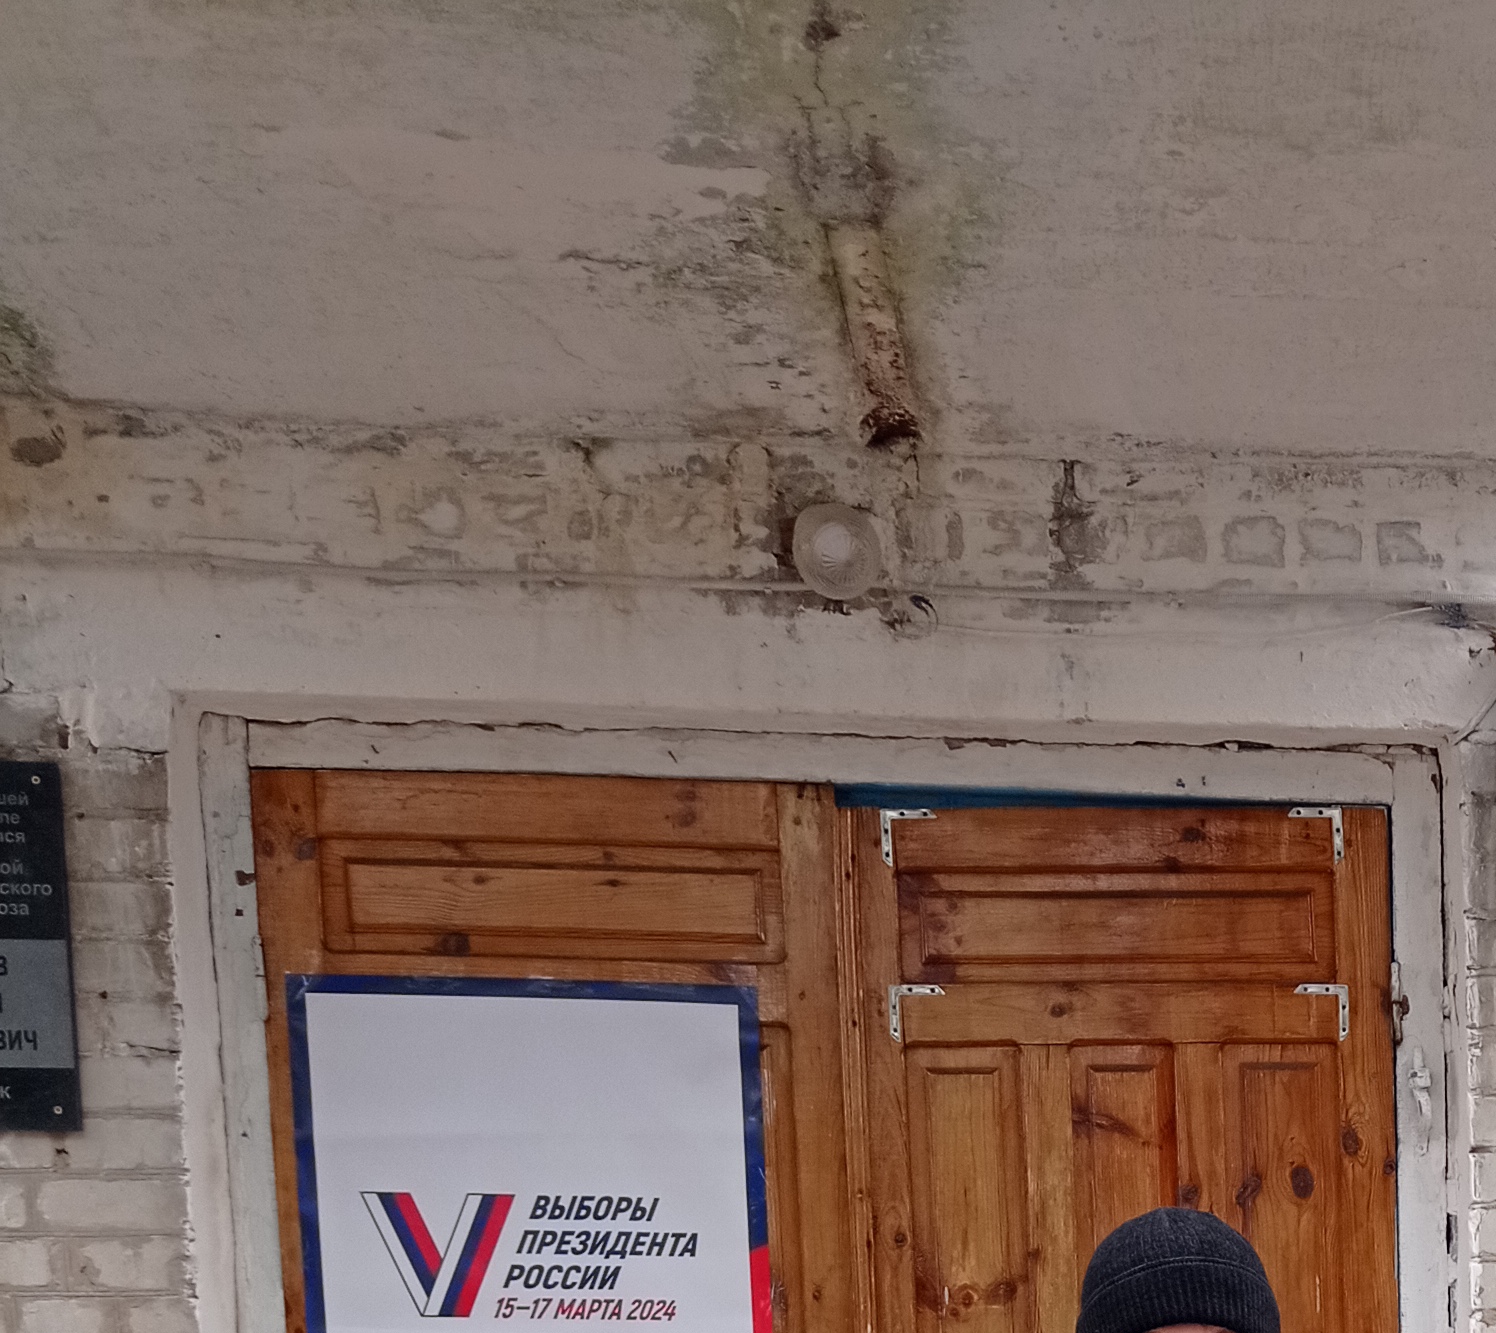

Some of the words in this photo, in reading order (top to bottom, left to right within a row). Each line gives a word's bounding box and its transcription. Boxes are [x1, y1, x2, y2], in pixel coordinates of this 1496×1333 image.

[529, 1195, 660, 1222] ВЫБОРЫ
[516, 1229, 698, 1259] ПРЕЗИДЕНТА
[503, 1264, 622, 1290] РОССИИ
[554, 1298, 623, 1321] МАРТА
[626, 1299, 677, 1321] 2024
